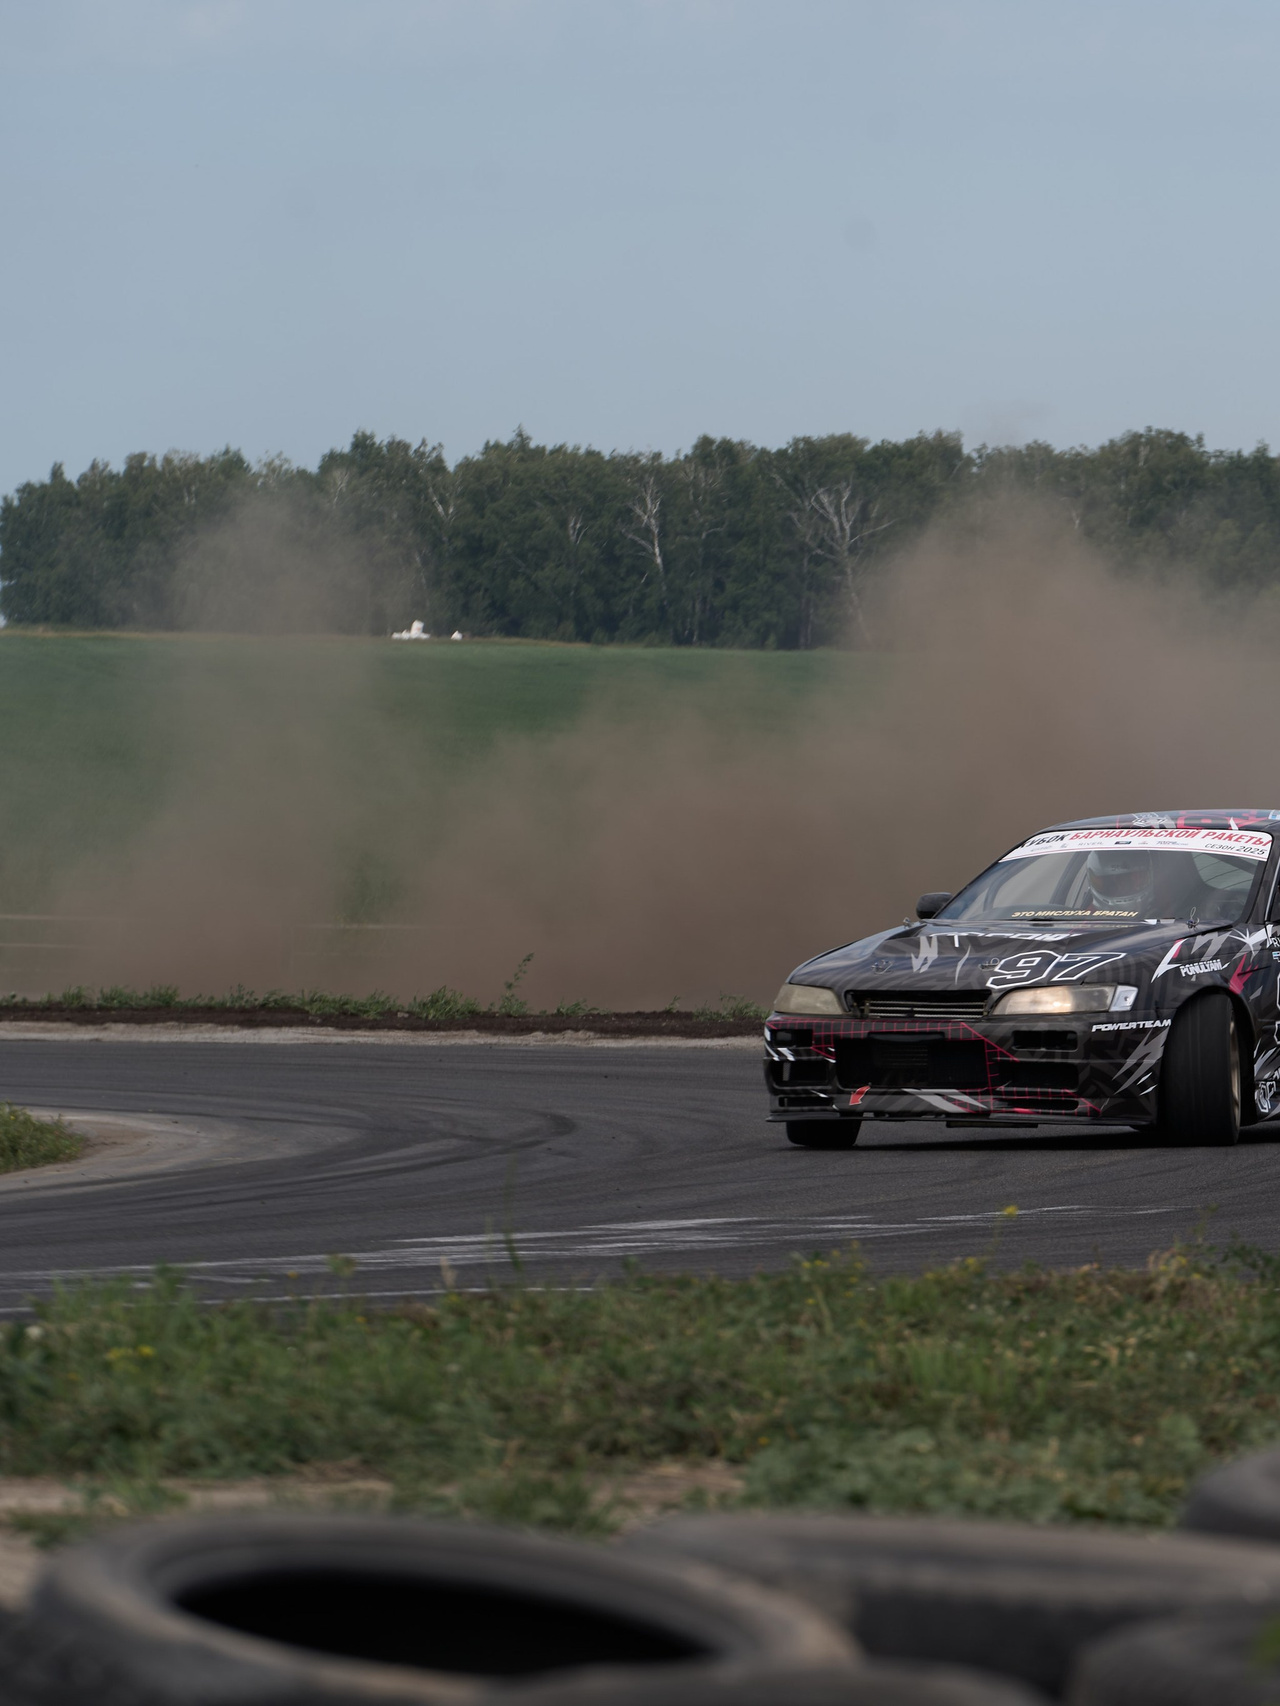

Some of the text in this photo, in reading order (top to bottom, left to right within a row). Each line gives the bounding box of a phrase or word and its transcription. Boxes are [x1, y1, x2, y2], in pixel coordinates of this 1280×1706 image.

[1069, 829, 1201, 841] БАРНАУЛЬСКОЙ
[1201, 831, 1272, 847] РАКЕТЫ
[1204, 843, 1268, 855] СЕЗОН 2025
[1092, 910, 1139, 918] БРАТАН
[986, 950, 1127, 989] 97
[1091, 1019, 1172, 1032] POWERTEAM
